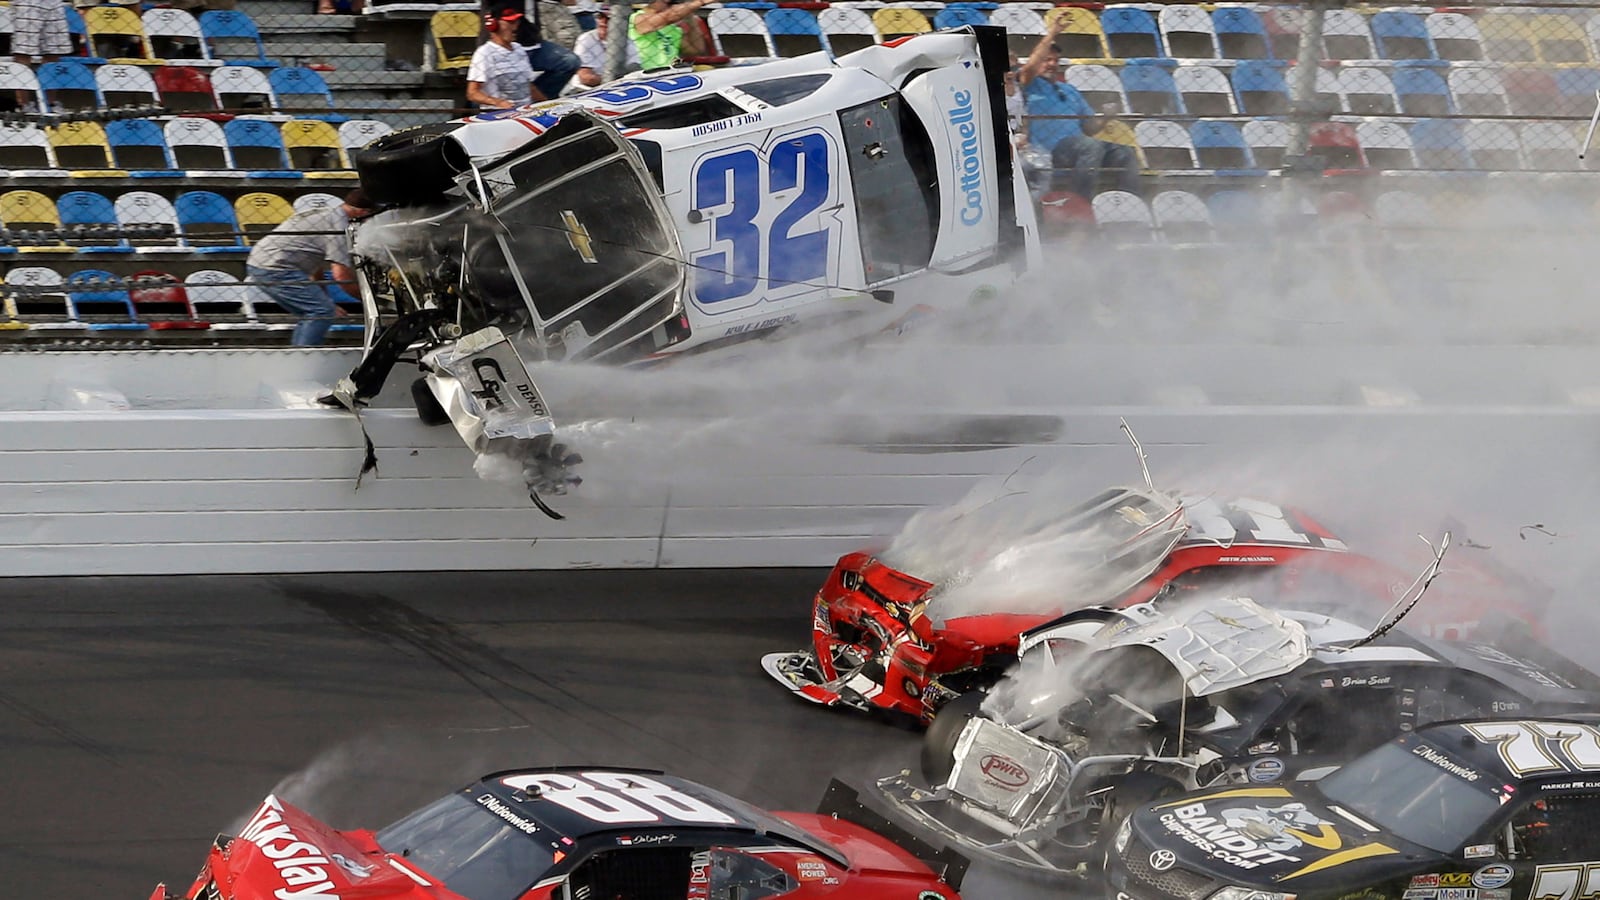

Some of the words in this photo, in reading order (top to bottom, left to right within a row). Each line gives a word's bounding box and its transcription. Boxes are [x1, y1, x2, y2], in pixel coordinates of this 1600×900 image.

[112, 68, 128, 78] 55
[948, 89, 984, 226] Cottonelle
[692, 130, 833, 307] 32
[516, 384, 545, 416] DENSO
[1341, 676, 1367, 687] Brian
[1367, 675, 1391, 686] Scott
[1420, 748, 1478, 782] Nationwide
[1460, 721, 1600, 779] 77
[483, 795, 539, 835] Nationwide
[502, 772, 737, 823] 88
[1159, 813, 1261, 870] CHIPPERS.COM
[1174, 802, 1302, 864] BANDIT
[797, 862, 826, 870] AMERICAN
[801, 870, 827, 878] POWER
[1441, 889, 1465, 899] Mobil
